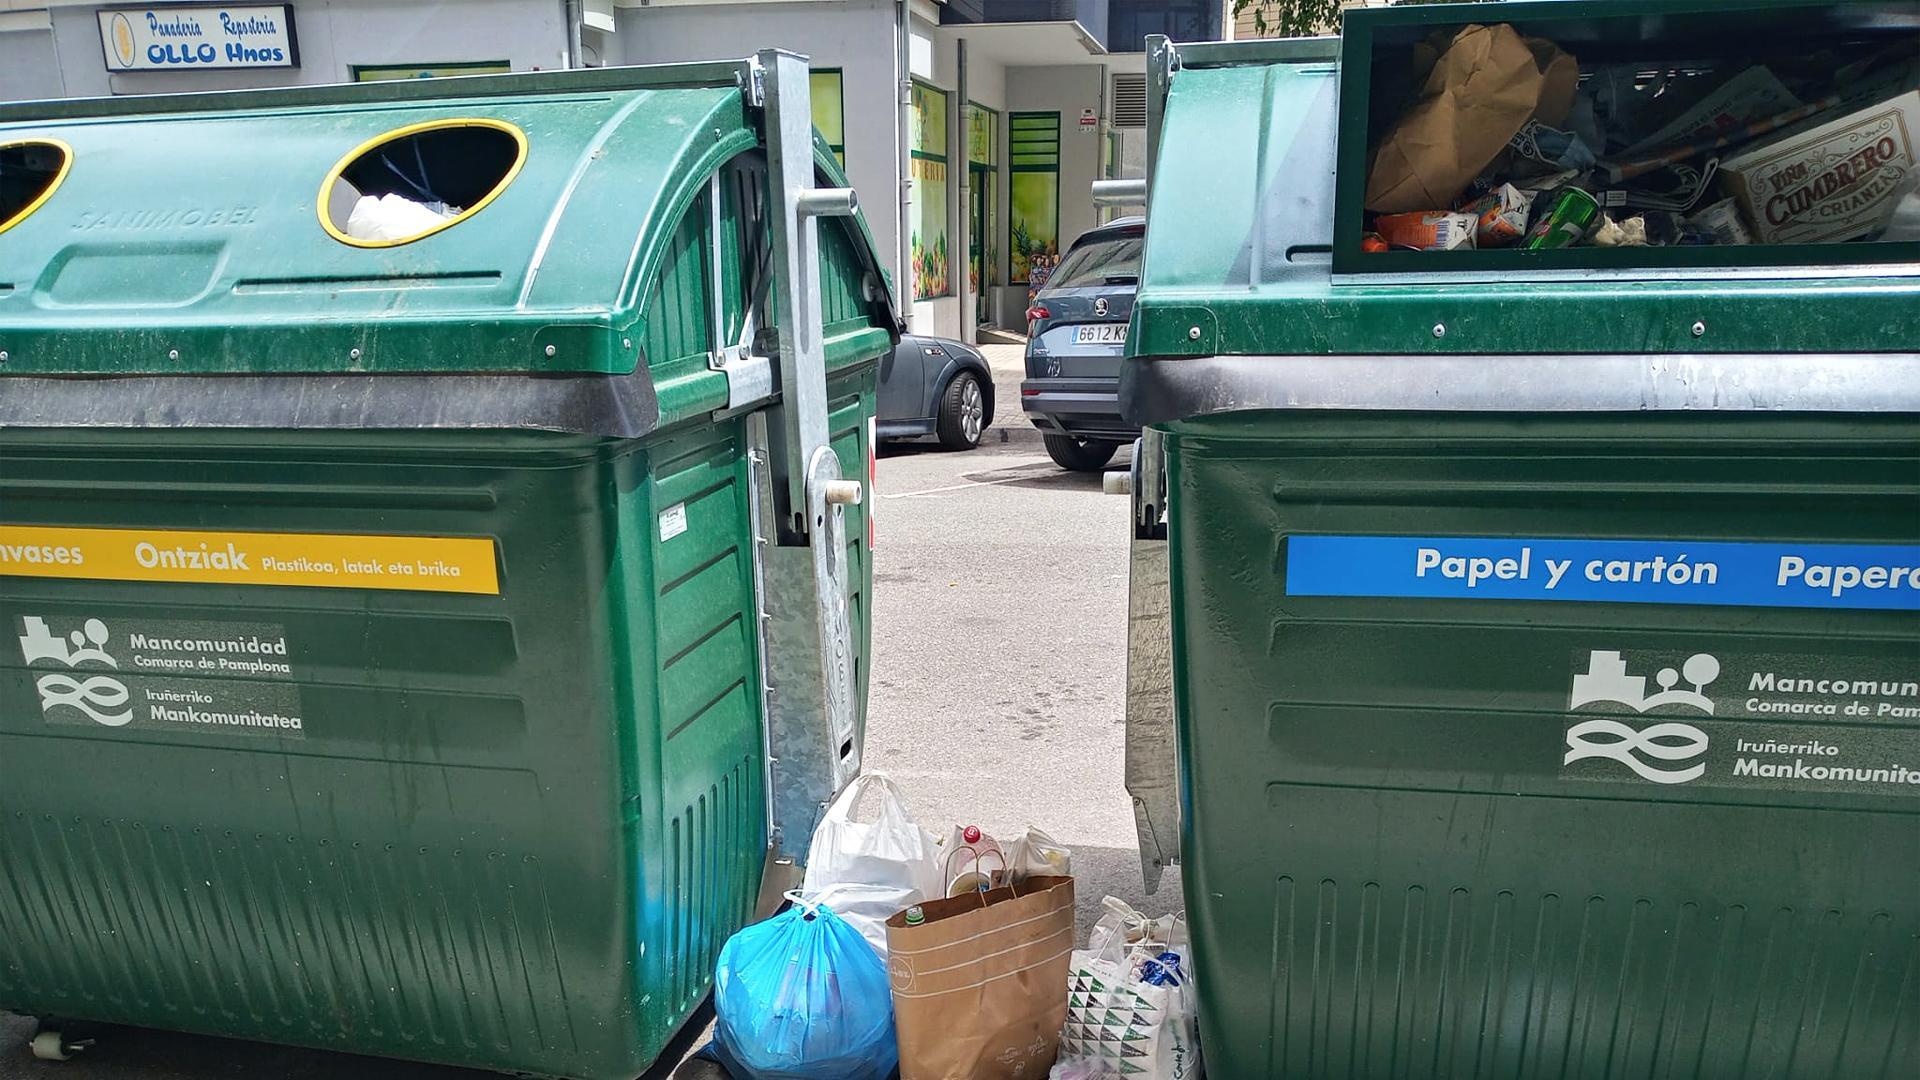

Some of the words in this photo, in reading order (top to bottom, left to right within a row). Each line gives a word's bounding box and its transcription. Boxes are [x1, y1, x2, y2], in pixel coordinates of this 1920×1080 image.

[147, 43, 216, 64] OLLO
[225, 43, 283, 62] Hnas
[1765, 136, 1896, 226] CUMBRERO
[1079, 326, 1111, 341] 6612
[0, 544, 84, 565] nvases
[134, 542, 250, 570] Ontziak
[262, 556, 339, 575] Plastikoa,
[343, 558, 384, 574] latak
[388, 562, 414, 576] eta
[418, 561, 461, 577] brika
[1416, 547, 1531, 588] Papel
[1544, 559, 1572, 590] y
[1584, 554, 1718, 585] cartón
[130, 633, 287, 655] Mancomunidad
[134, 654, 194, 669] Comarca
[199, 657, 215, 669] de
[218, 658, 291, 674] Pamplona
[1748, 672, 1919, 696] Mancomun
[145, 688, 213, 704] Iruñerriko
[150, 705, 302, 729] Mankomunitatea
[1745, 698, 1837, 715] Comarca
[1844, 701, 1870, 716] de
[1876, 702, 1920, 718] Pam
[1736, 738, 1839, 756] Iruñerriko
[1733, 758, 1920, 784] Mankomunita
